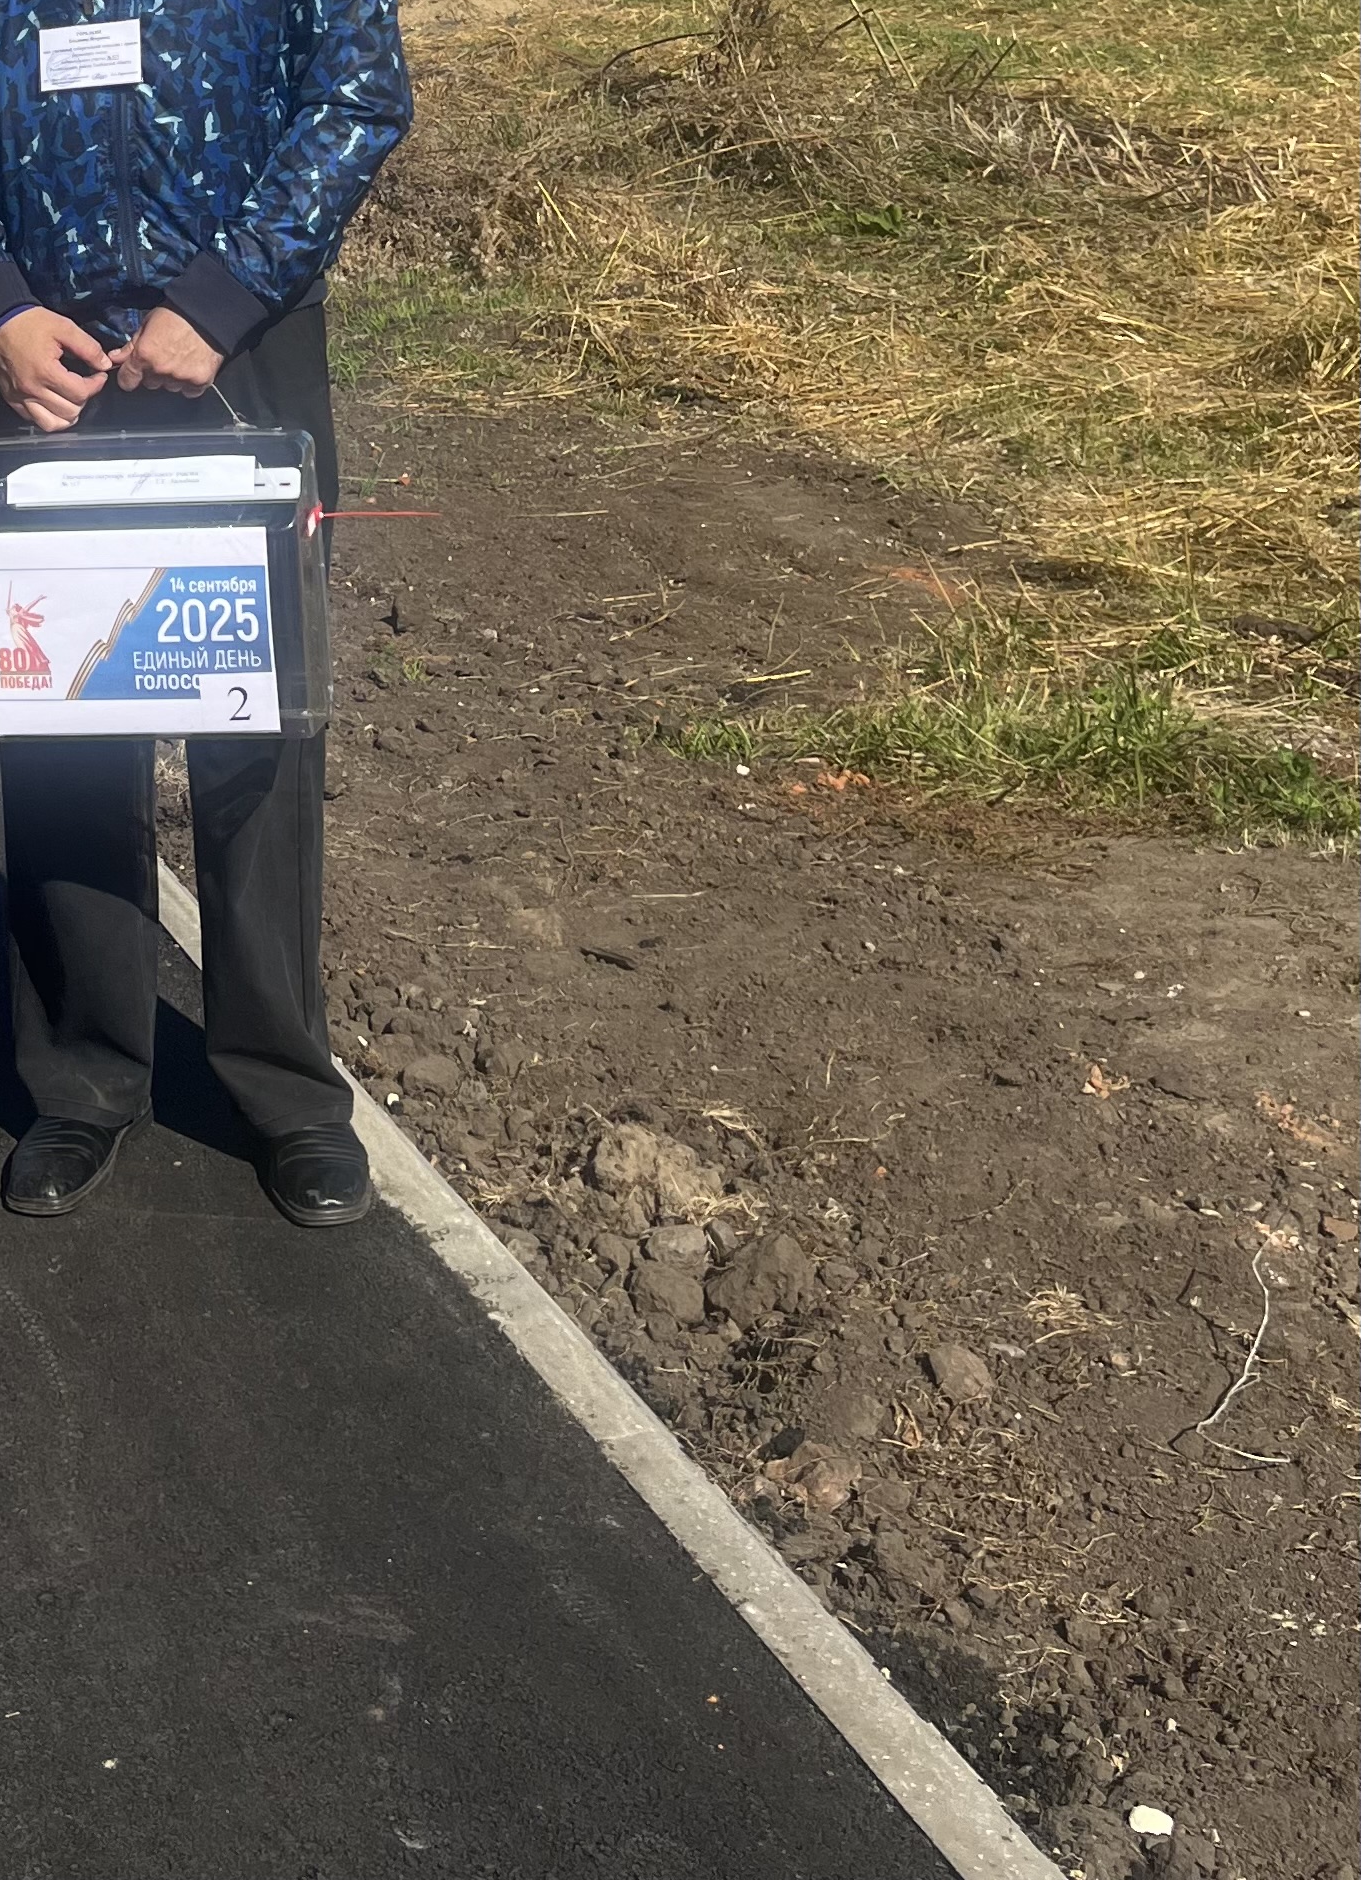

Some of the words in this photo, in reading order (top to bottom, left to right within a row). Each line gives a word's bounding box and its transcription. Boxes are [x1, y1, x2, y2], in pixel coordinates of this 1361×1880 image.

[170, 577, 185, 593] 14
[188, 576, 257, 596] сентября
[155, 597, 260, 643] 2025
[133, 646, 208, 672] ЕДИНЫЙ
[214, 649, 262, 671] ДЕНЬ
[0, 674, 53, 691] ПОБЕДА!
[226, 686, 252, 721] 2
